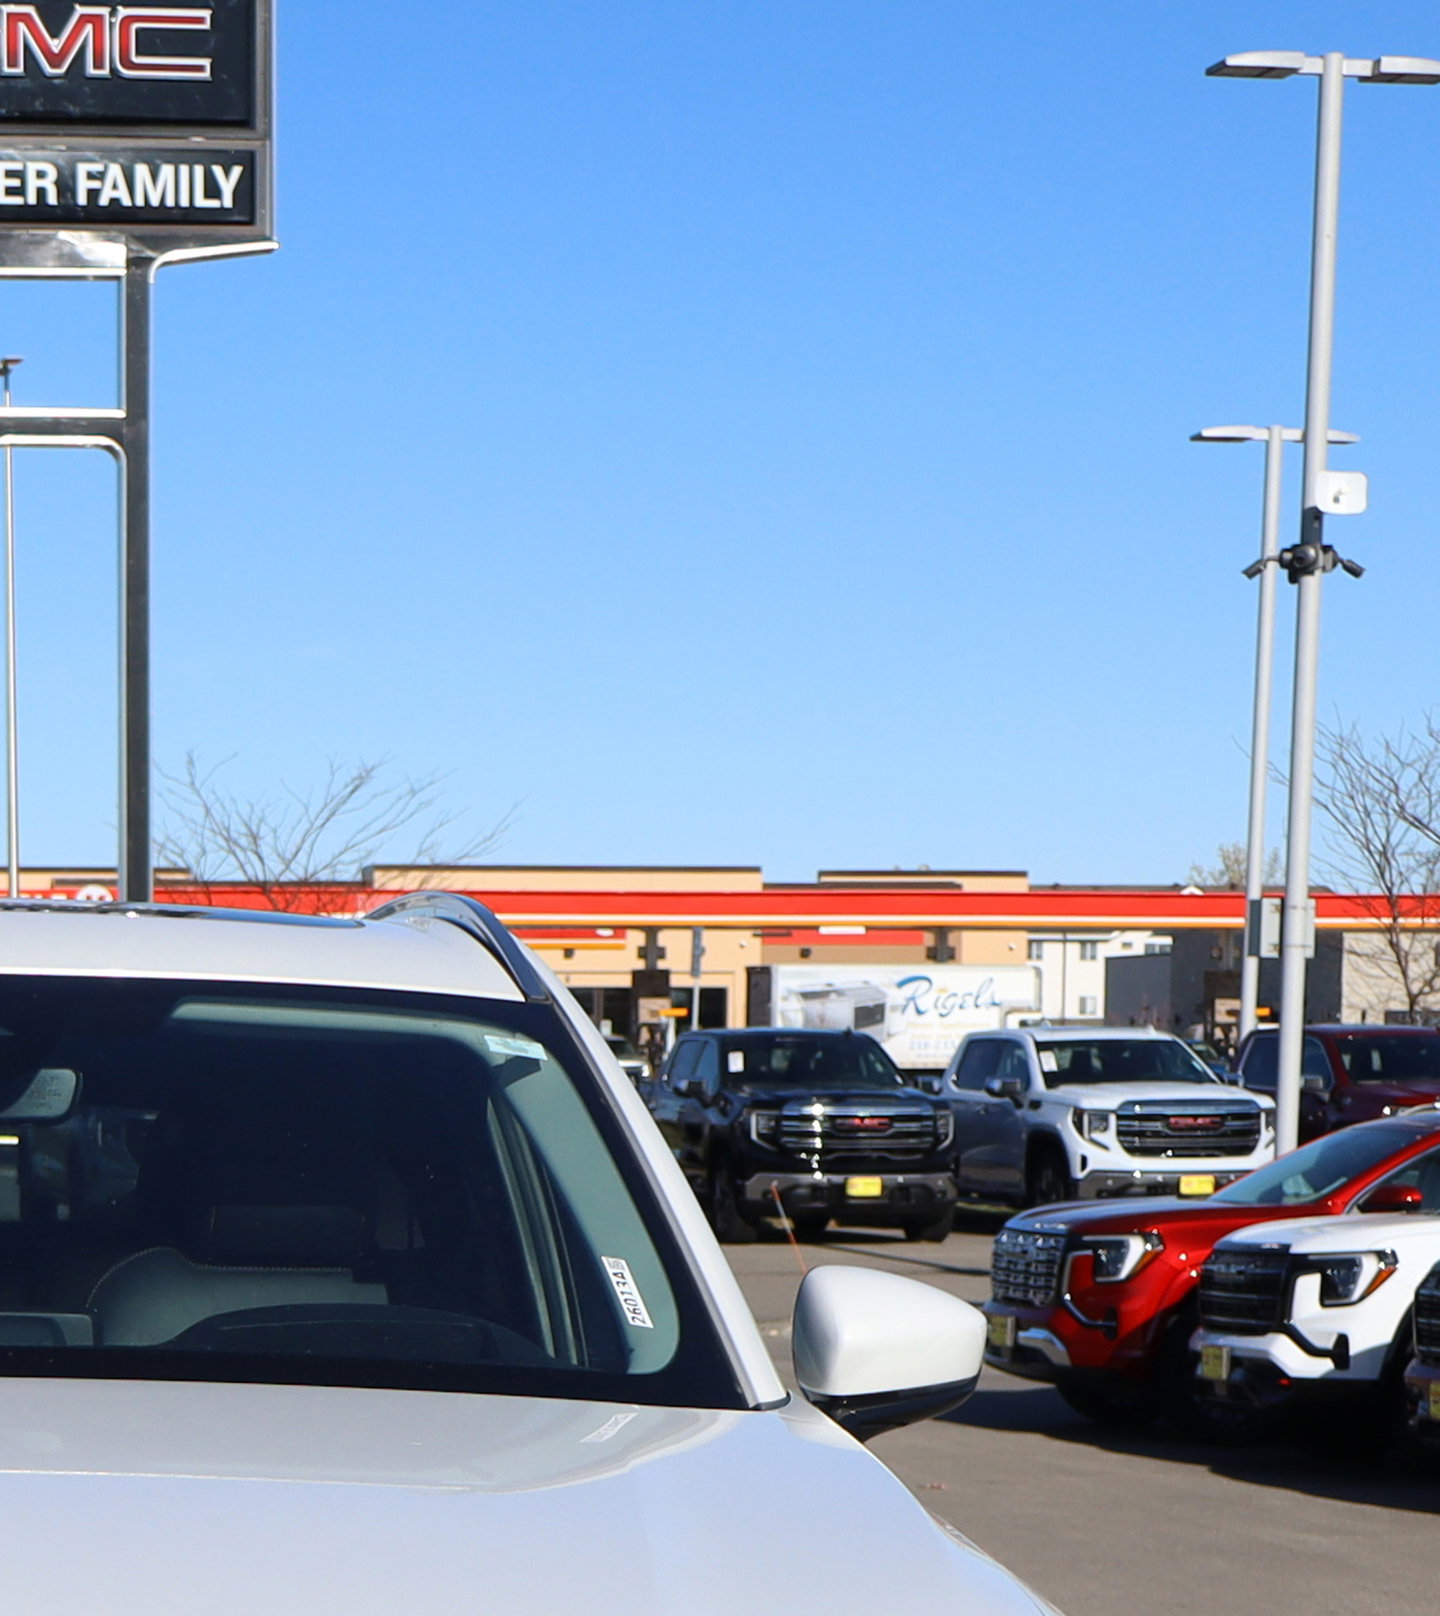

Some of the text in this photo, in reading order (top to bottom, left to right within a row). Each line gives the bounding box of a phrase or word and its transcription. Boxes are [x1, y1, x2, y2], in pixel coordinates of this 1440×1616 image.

[75, 162, 244, 209] FAMILY
[896, 975, 1002, 1018] Rigels
[612, 1271, 647, 1325] 26013A
